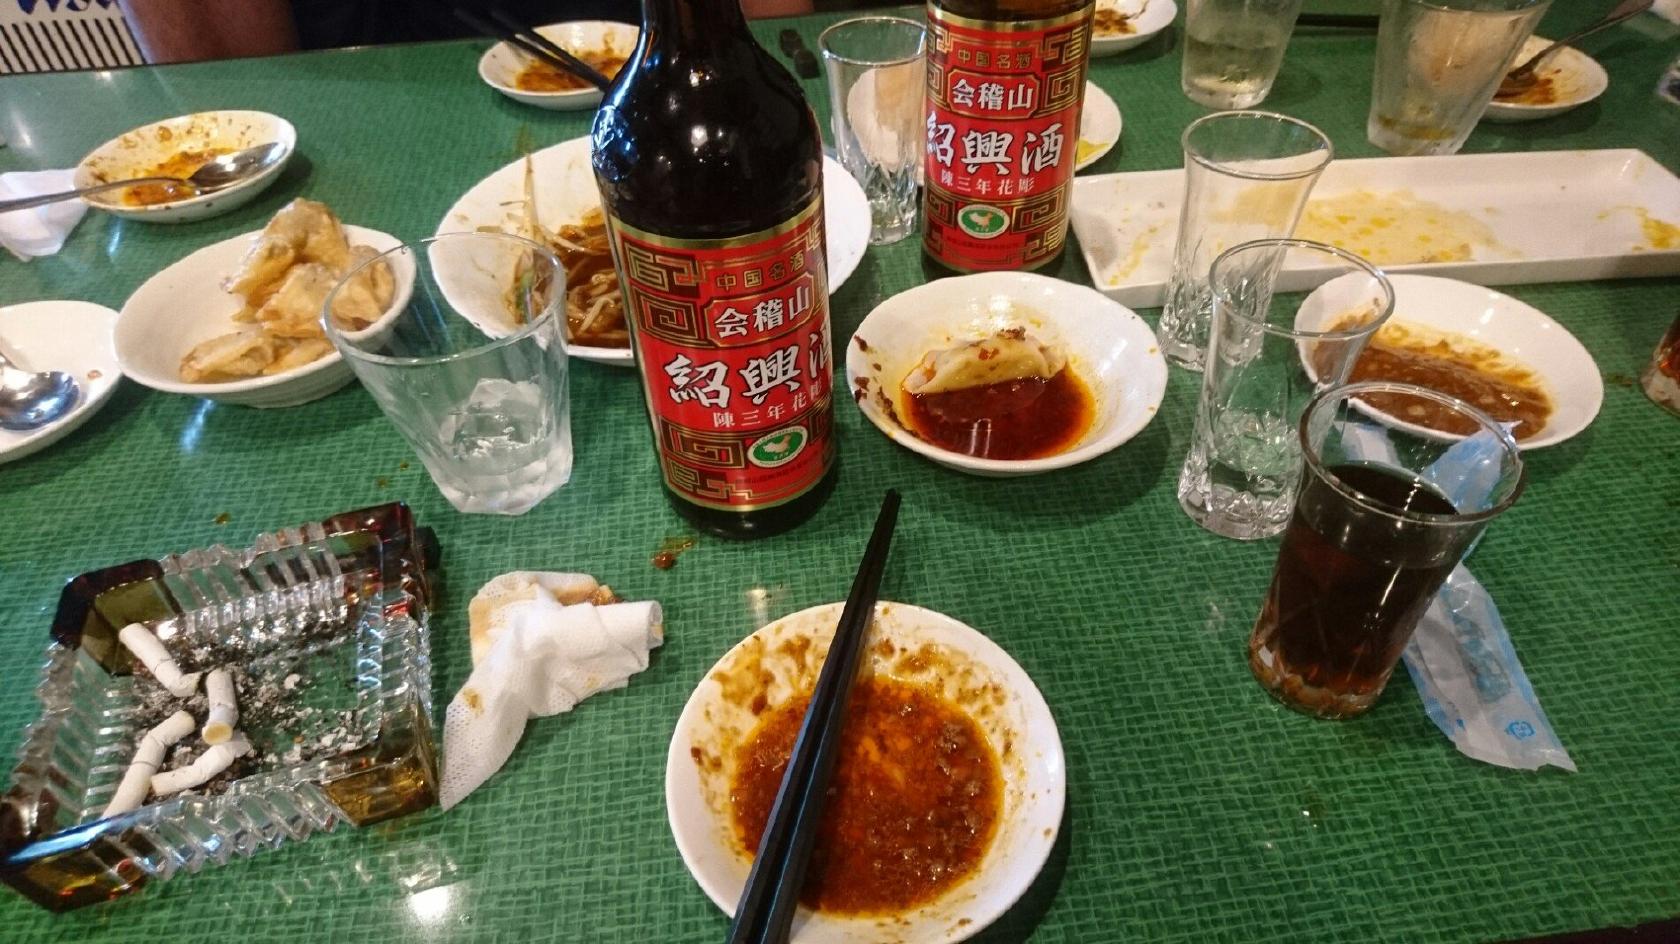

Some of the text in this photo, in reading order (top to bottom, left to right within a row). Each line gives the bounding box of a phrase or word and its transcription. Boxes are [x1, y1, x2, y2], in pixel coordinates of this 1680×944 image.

[957, 49, 1032, 68] 中国名酒
[952, 79, 1033, 110] 会稽山
[927, 110, 1065, 176] 紹興酒
[716, 250, 804, 291] 中国名酒
[714, 285, 810, 338] 会稽山
